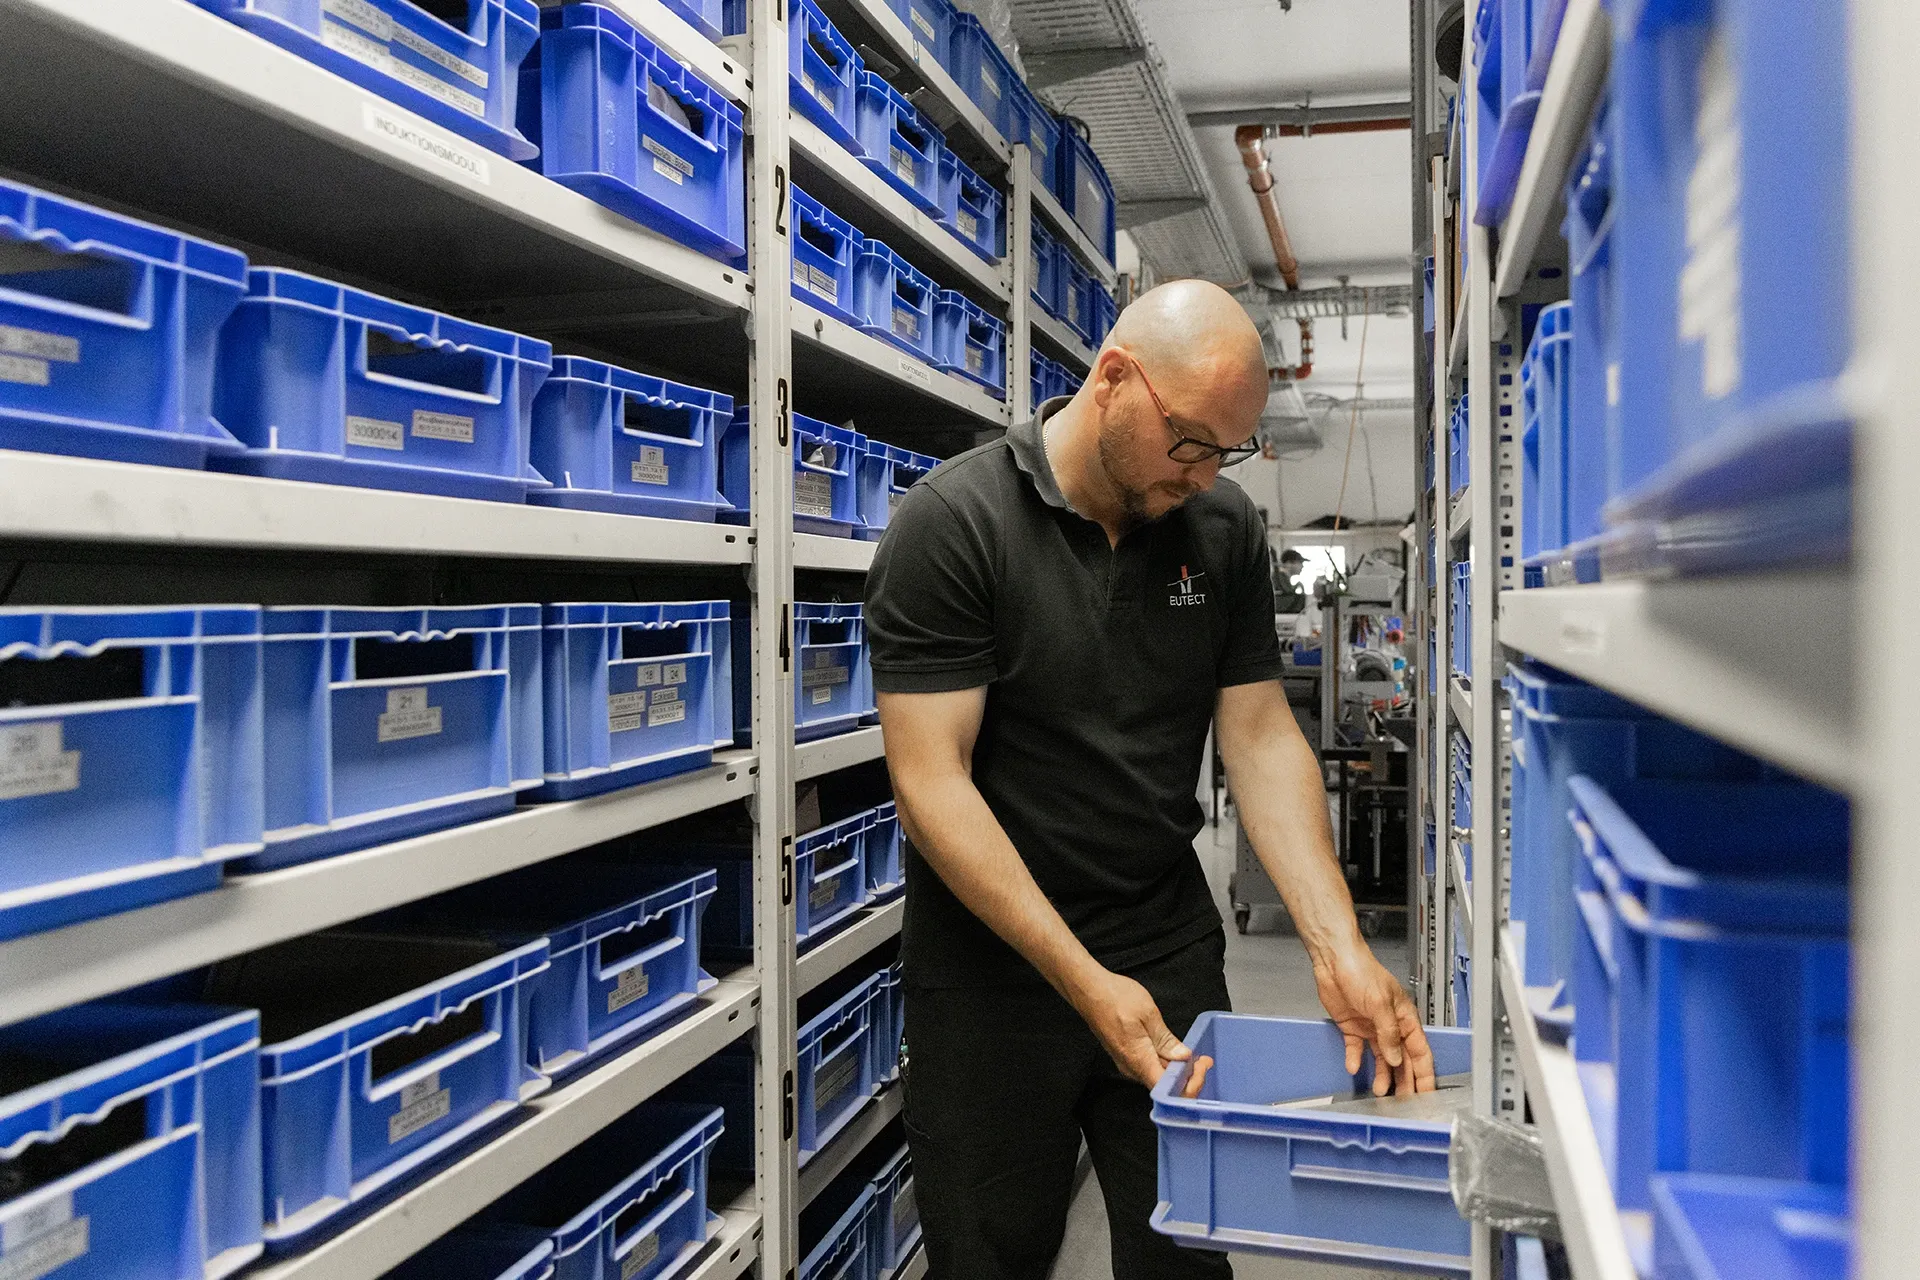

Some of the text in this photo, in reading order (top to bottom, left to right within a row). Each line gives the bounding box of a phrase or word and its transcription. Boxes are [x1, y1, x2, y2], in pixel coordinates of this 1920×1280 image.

[374, 116, 480, 175] INDUKTIONSMODUL
[775, 164, 786, 237] 2
[777, 377, 788, 447] 3
[1170, 594, 1205, 606] EUTECT
[779, 604, 790, 672] 4
[781, 835, 792, 906] 5
[783, 1070, 793, 1141] 6
